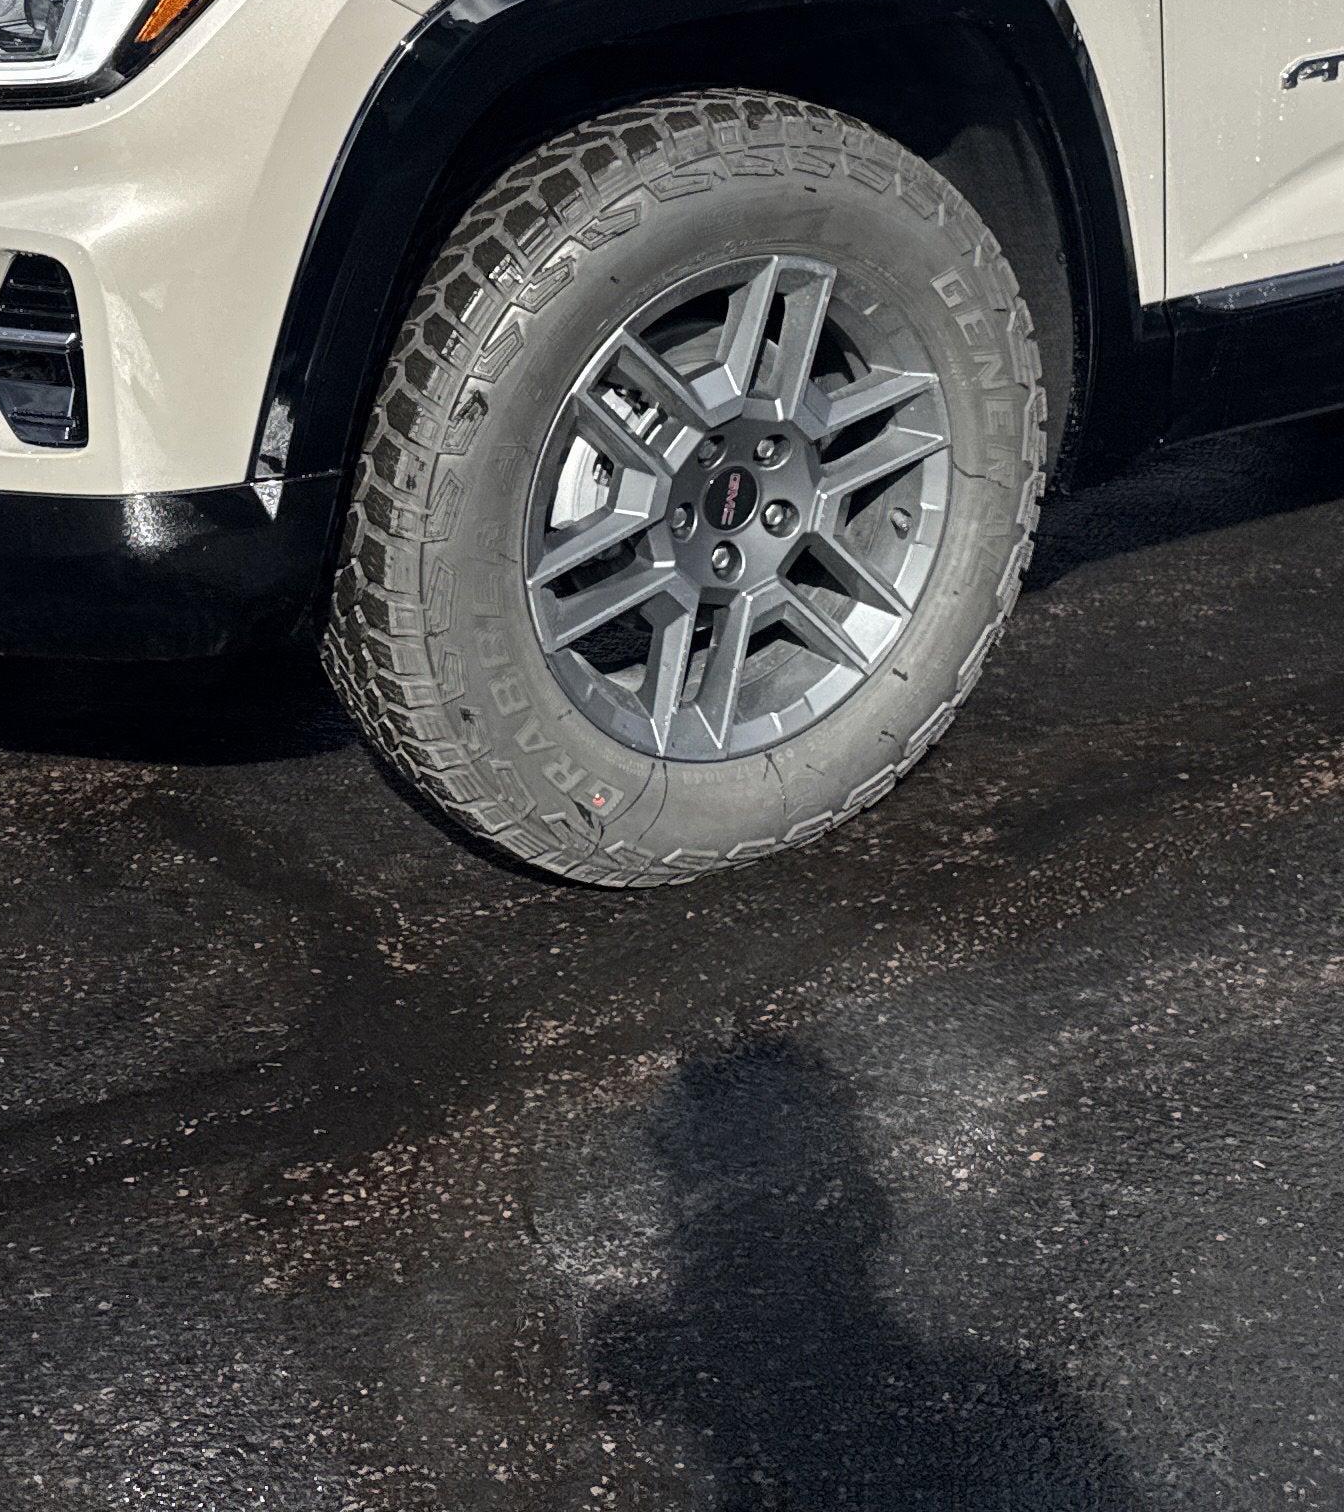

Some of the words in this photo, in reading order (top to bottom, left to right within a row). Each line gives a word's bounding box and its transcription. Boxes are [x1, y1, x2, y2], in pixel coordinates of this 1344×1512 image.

[721, 472, 741, 526] GMC
[930, 266, 1020, 590] GENERAL
[473, 518, 624, 817] GRABBER
